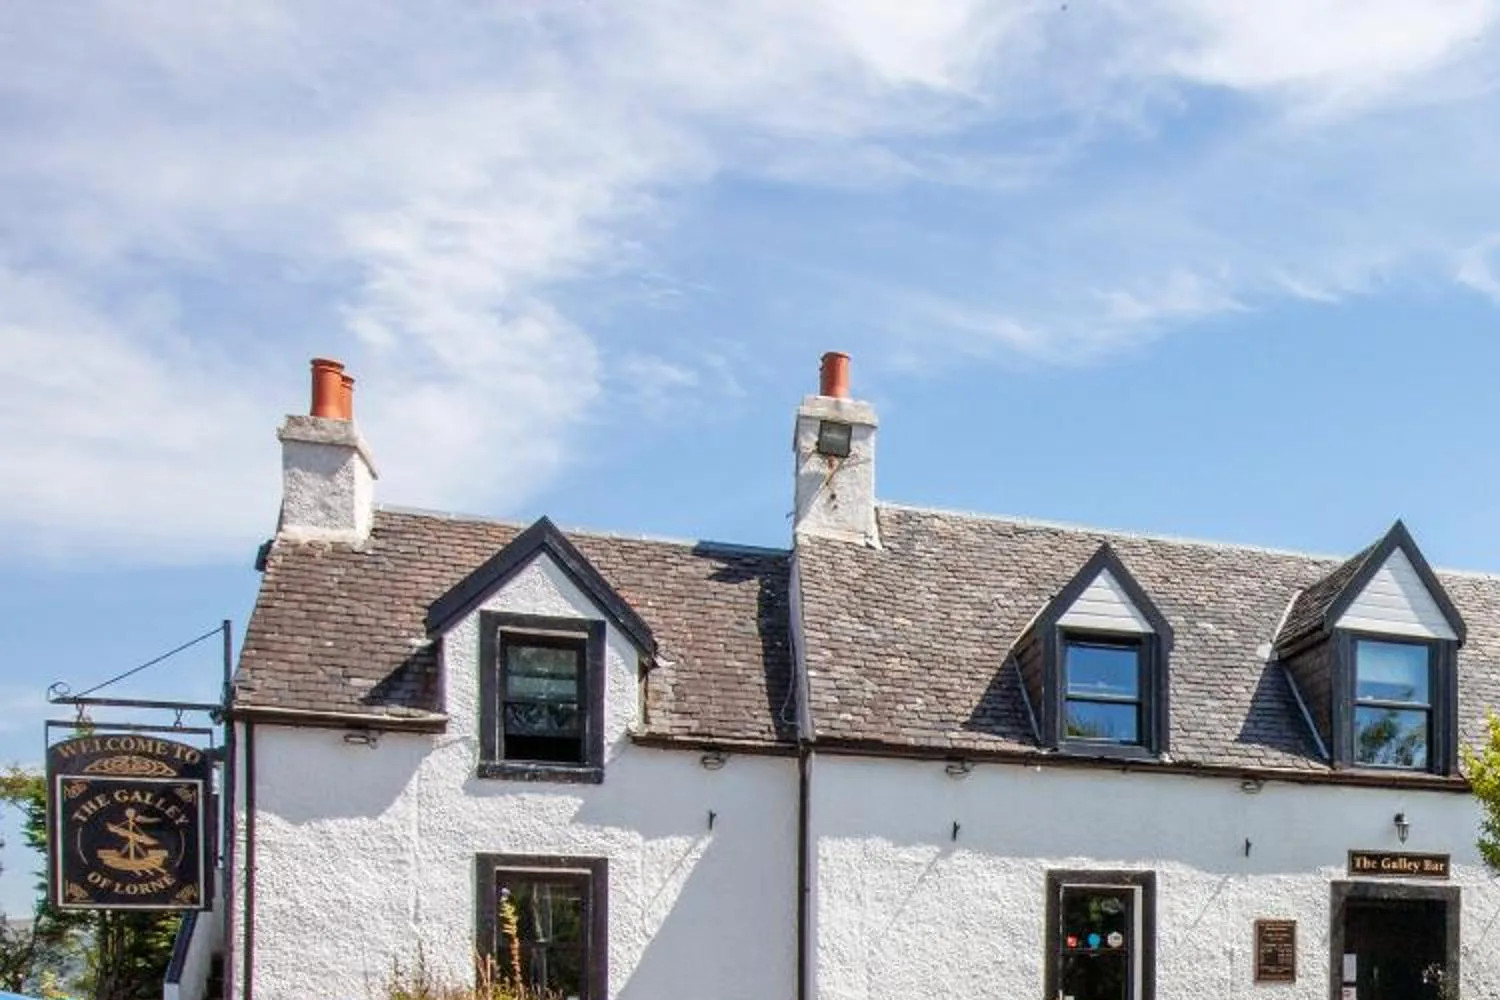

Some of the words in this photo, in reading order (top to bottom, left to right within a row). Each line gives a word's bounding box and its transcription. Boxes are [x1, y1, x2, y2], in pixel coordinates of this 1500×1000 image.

[59, 736, 169, 758] WELCOME
[174, 744, 200, 764] TO
[72, 794, 110, 822] THE
[113, 789, 189, 825] GALLEY
[1354, 856, 1377, 869] The
[1381, 857, 1420, 873] Galley
[1423, 859, 1445, 871] Bar
[87, 871, 113, 889] OF
[114, 873, 176, 894] LORNE
